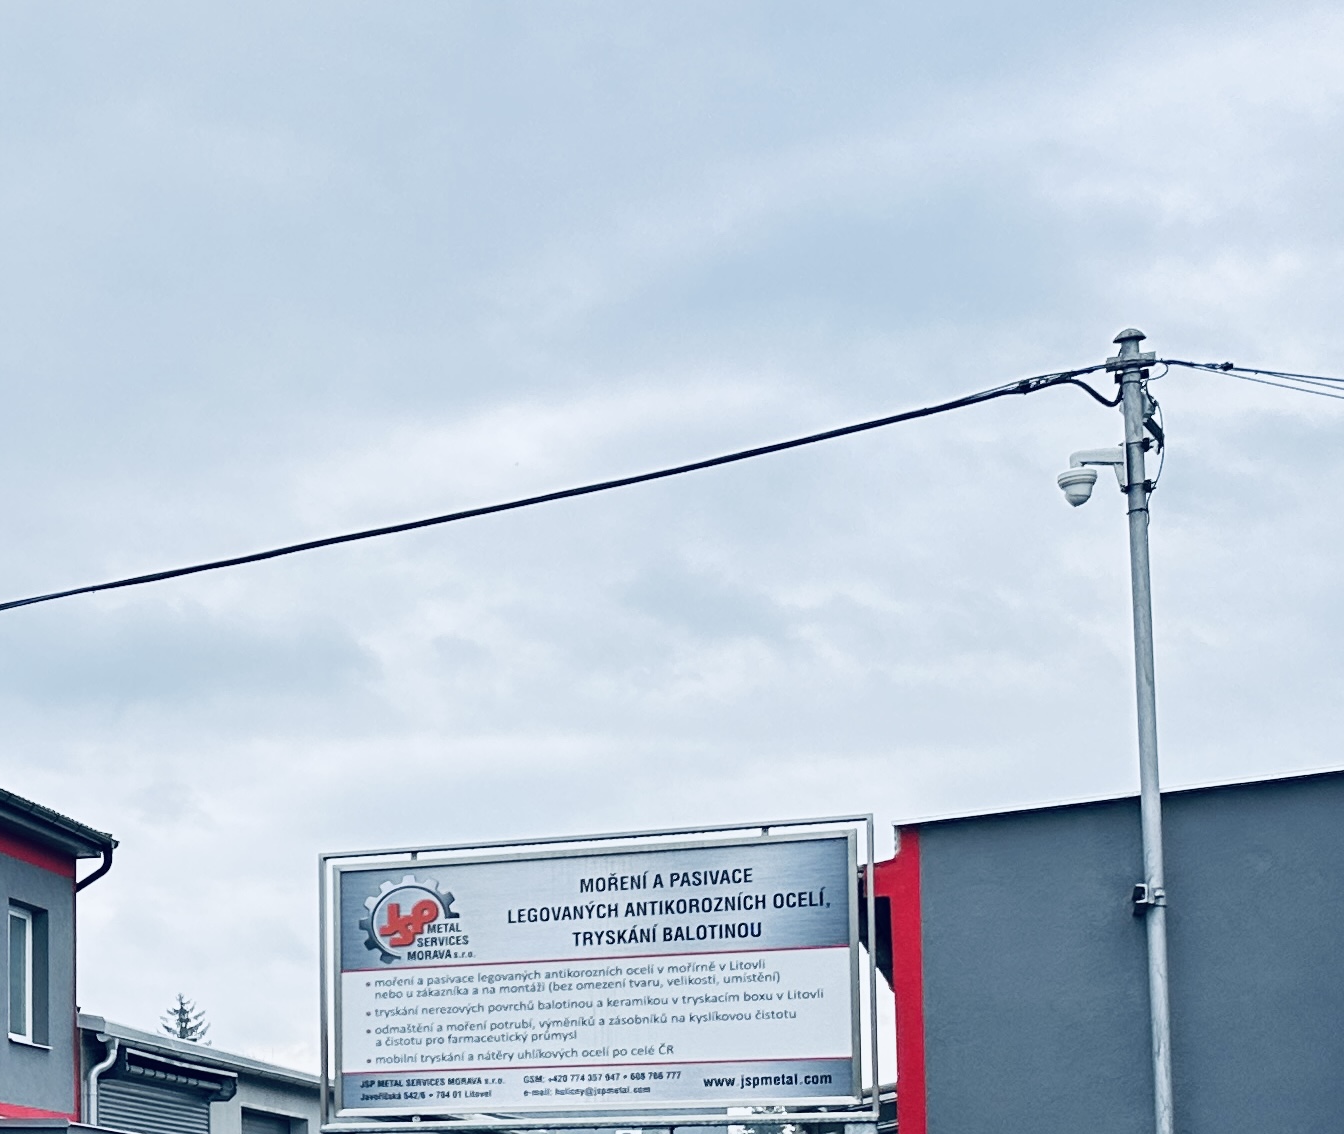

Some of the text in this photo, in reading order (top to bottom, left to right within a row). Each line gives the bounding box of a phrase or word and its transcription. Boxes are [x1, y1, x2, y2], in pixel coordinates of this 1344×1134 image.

[580, 868, 753, 893] MOŘENÍ A PASIVACE
[508, 887, 831, 924] LEGOVANÝCH ANTIKOROZNÍCH OCELÍ,
[380, 899, 439, 947] JSP
[427, 923, 461, 933] METAL
[573, 922, 762, 946] TRYSKÁNÍ BALOTINOU
[417, 935, 469, 947] SERVICES
[408, 950, 452, 960] MORAVA
[375, 976, 414, 987] moření
[427, 974, 474, 987] pasivace
[478, 971, 541, 984] legovaných
[545, 966, 622, 978] antikorozních
[626, 964, 654, 975] ocelí
[667, 962, 716, 973] mořírně
[719, 963, 725, 971] v
[729, 959, 765, 971] Litovli
[375, 989, 403, 999] nebo
[406, 990, 412, 998] u
[417, 986, 469, 997] zákazníka
[472, 987, 478, 995] a
[482, 986, 495, 994] na
[549, 981, 572, 993] (bez
[576, 978, 626, 990] omezení
[629, 976, 663, 989] tvaru,
[724, 971, 780, 984] umístění)
[375, 1006, 418, 1018] tryskání
[422, 1002, 484, 1016] nerezových
[488, 1001, 534, 1013] povrchů
[538, 999, 592, 1010] balotinou
[597, 999, 603, 1007] a
[607, 996, 668, 1007] keramikou
[682, 992, 739, 1005] tryskacím
[744, 991, 773, 1001] boxu
[777, 992, 783, 1000] v
[788, 989, 824, 1000] Litovli
[375, 1023, 433, 1035] odmaštění
[447, 1022, 486, 1031] moření
[490, 1019, 535, 1032] potrubí,
[539, 1016, 595, 1029] výměníků
[599, 1018, 604, 1026] a
[609, 1013, 667, 1025] zásobníků
[671, 1015, 685, 1023] na
[689, 1011, 751, 1024] kyslíkovou
[755, 1009, 796, 1020] čistotu
[385, 1036, 422, 1046] čistotu
[426, 1037, 444, 1047] pro
[448, 1032, 528, 1045] farmaceutický
[532, 1030, 577, 1042] průmysl
[376, 1054, 417, 1064] mobilní
[421, 1051, 464, 1063] tryskání
[478, 1050, 514, 1062] nátěry
[518, 1048, 578, 1061] uhlíkových
[582, 1046, 609, 1057] ocelí
[613, 1048, 627, 1058] po
[631, 1045, 655, 1056] celé
[658, 1043, 674, 1055] ČR
[406, 1078, 445, 1086] SERVICES
[448, 1077, 482, 1085] MORAVA
[703, 1074, 832, 1089] www.jspmetal.com
